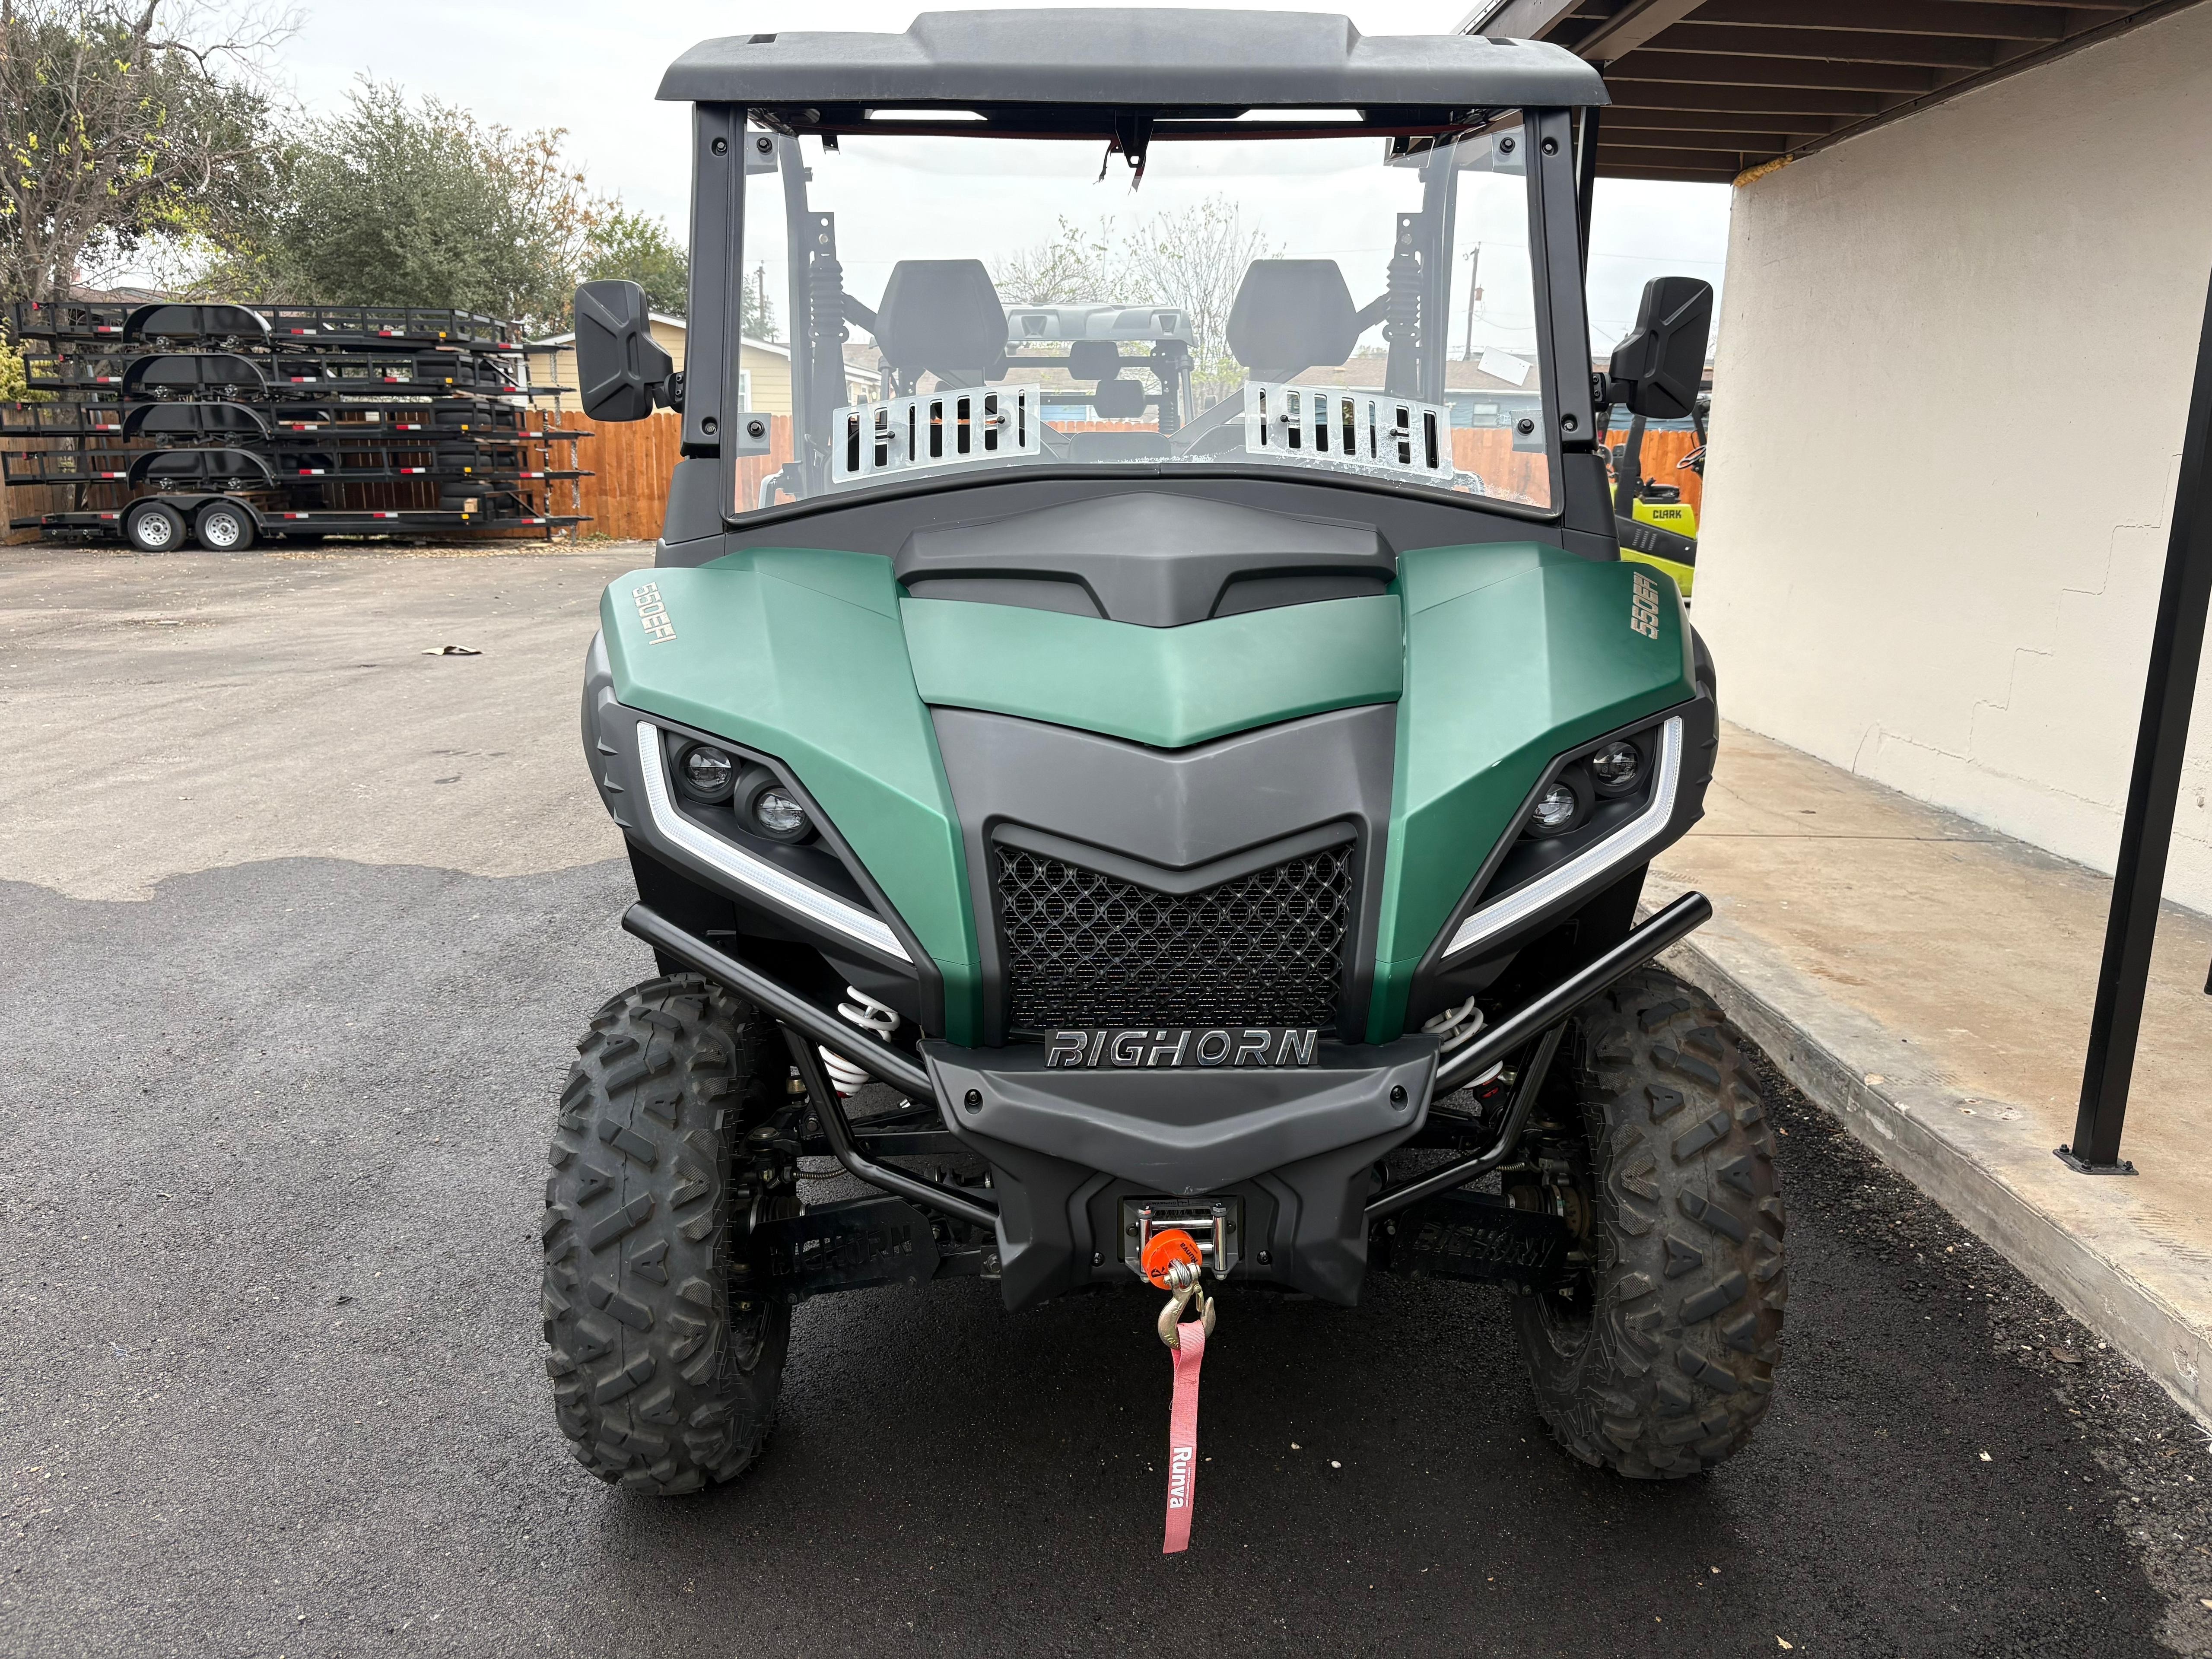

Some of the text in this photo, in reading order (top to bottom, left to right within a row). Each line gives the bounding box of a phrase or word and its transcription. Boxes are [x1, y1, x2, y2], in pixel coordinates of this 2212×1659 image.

[1653, 510, 1681, 519] CLARK
[632, 582, 677, 645] 550EFI
[1630, 571, 1658, 639] 550EFI
[1046, 1029, 1317, 1067] BIGHORN
[1180, 1242, 1198, 1263] Runva
[1170, 1447, 1192, 1508] Runva
